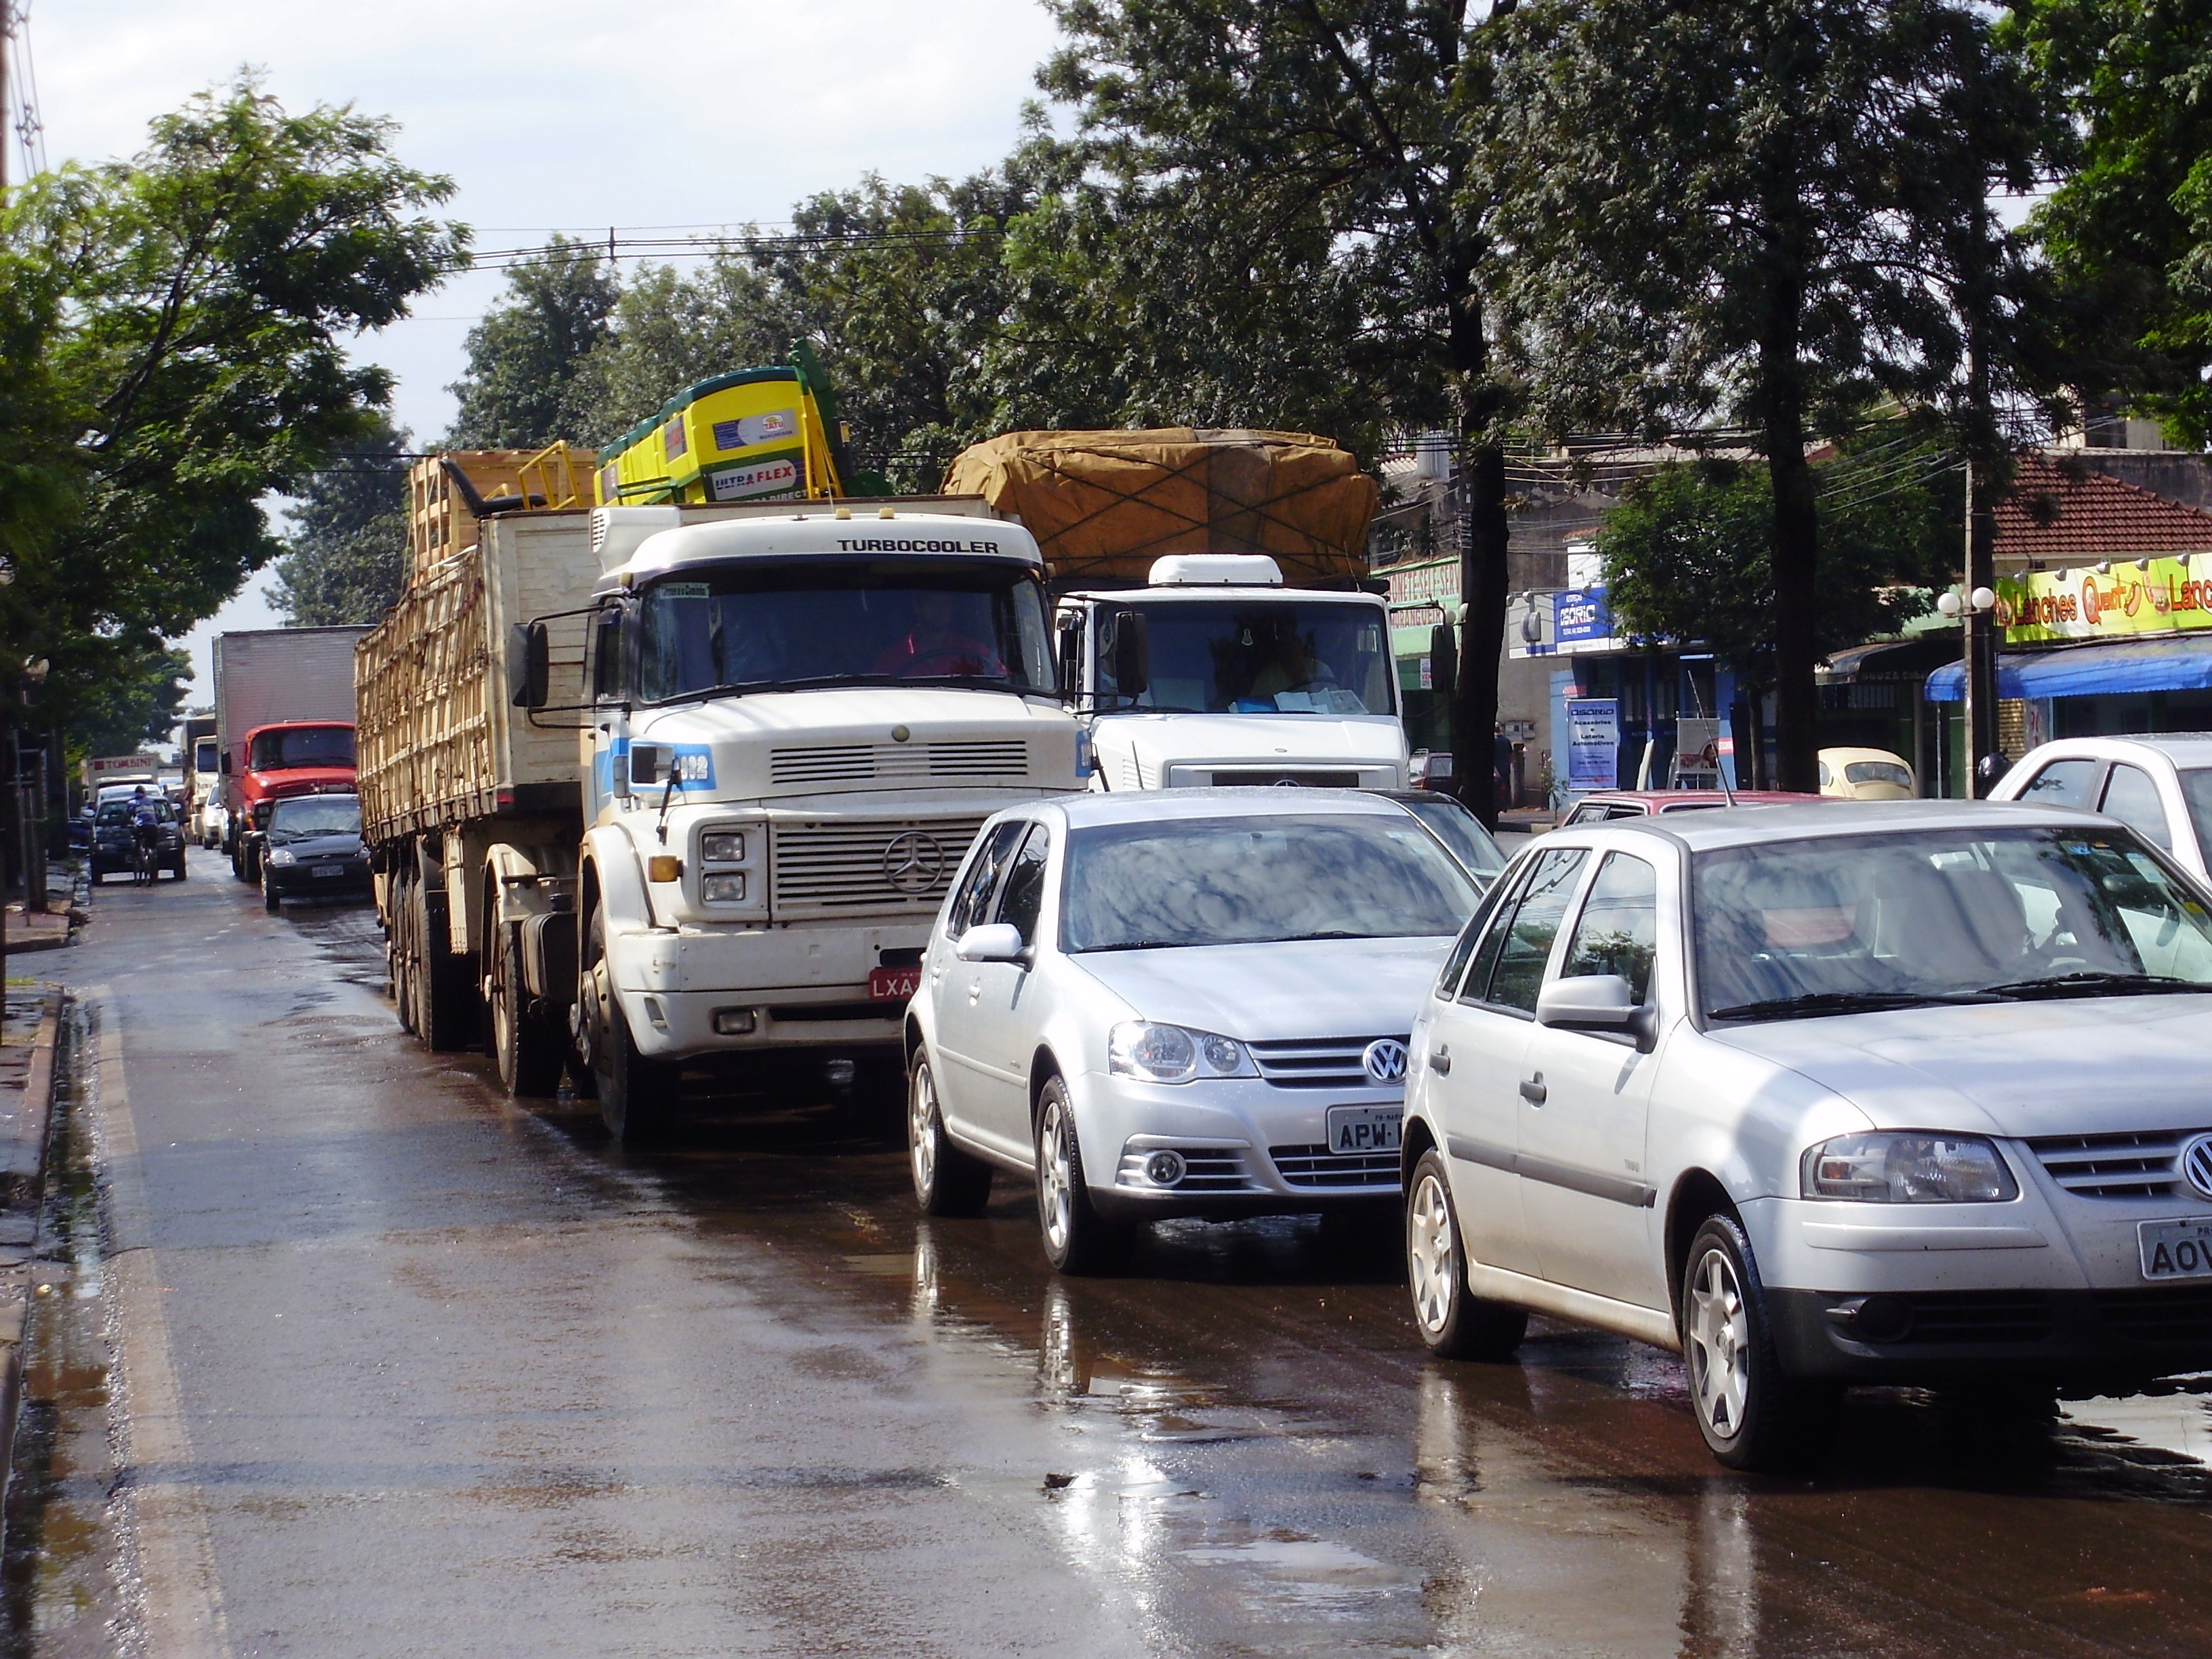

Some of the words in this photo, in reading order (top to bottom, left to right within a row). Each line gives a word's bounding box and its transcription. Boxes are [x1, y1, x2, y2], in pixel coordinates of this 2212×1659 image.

[764, 420, 784, 430] TATU
[837, 539, 999, 554] TURBOCOOLER
[2014, 588, 2078, 626] Lanches
